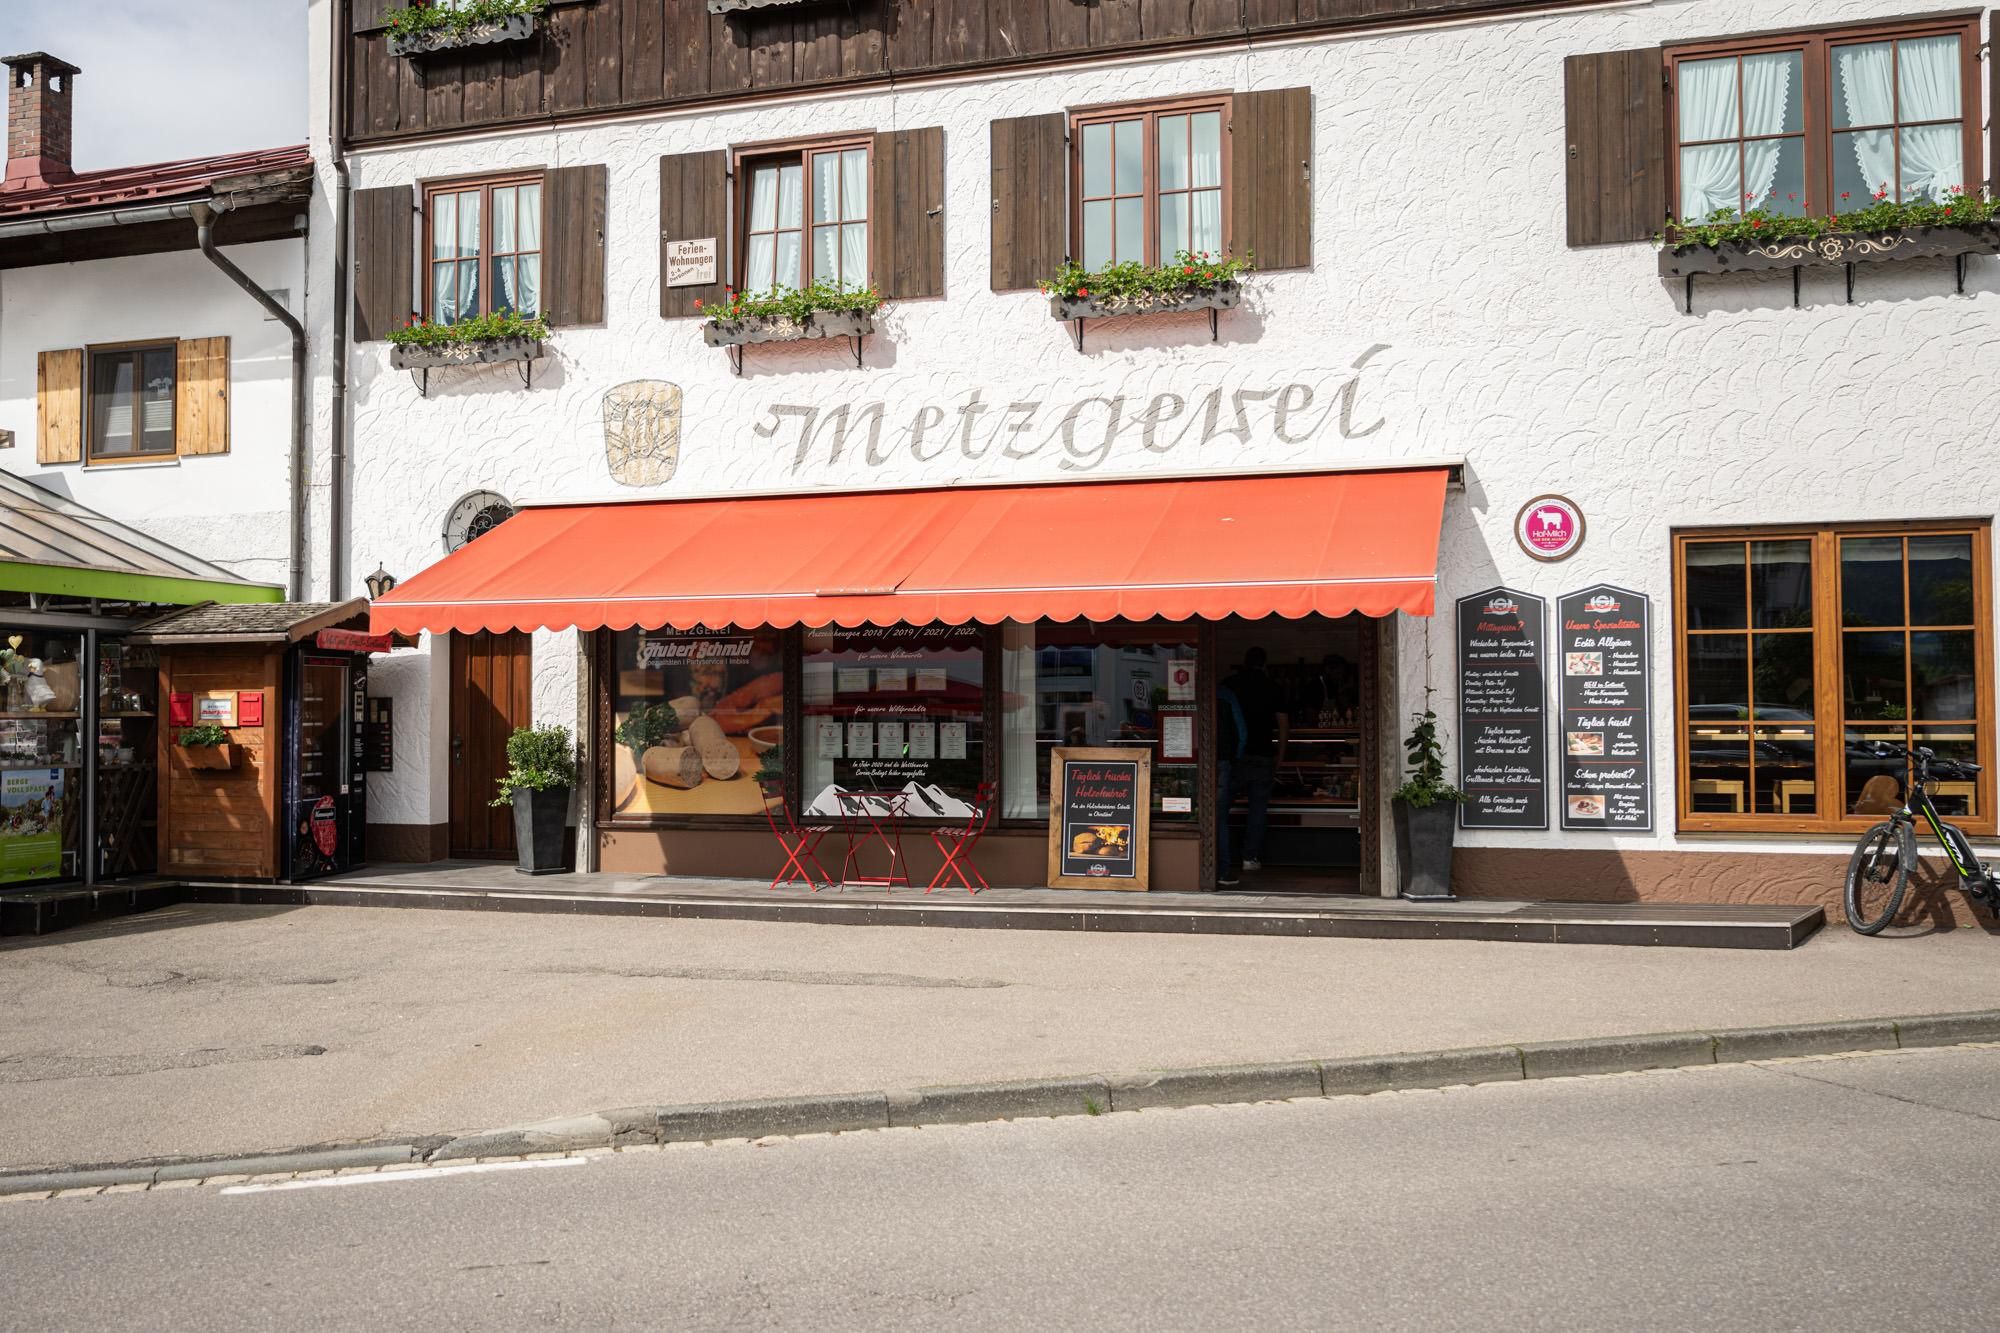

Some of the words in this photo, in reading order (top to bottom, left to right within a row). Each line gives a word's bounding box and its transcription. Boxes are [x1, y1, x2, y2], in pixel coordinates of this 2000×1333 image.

[678, 244, 707, 255] Ferien-
[669, 255, 713, 267] Wohnungen
[1532, 529, 1567, 537] Hof-Milch
[1565, 620, 1591, 630] Unsere
[1593, 619, 1641, 632] Spezialitäten
[863, 629, 882, 637] 2018
[894, 628, 914, 637] 2019
[924, 628, 944, 636] 2021
[954, 627, 976, 635] 2022
[1574, 637, 1595, 647] Echte
[1597, 637, 1632, 649] Allgäuer
[643, 642, 698, 658] Hubert
[697, 641, 754, 659] Schmid
[687, 658, 724, 666] Partyservice
[729, 657, 749, 665] Imbiss
[858, 652, 868, 661] für
[855, 705, 866, 714] für
[888, 704, 927, 713] Wildprodukte
[1577, 717, 1605, 729] Täglich
[1607, 716, 1632, 727] frisch!
[1484, 727, 1504, 736] Täglich
[1071, 768, 1101, 784] Täglich
[1575, 768, 1598, 779] Schon
[1599, 768, 1636, 781] probiert?
[1075, 785, 1128, 798] Holzofenbrot
